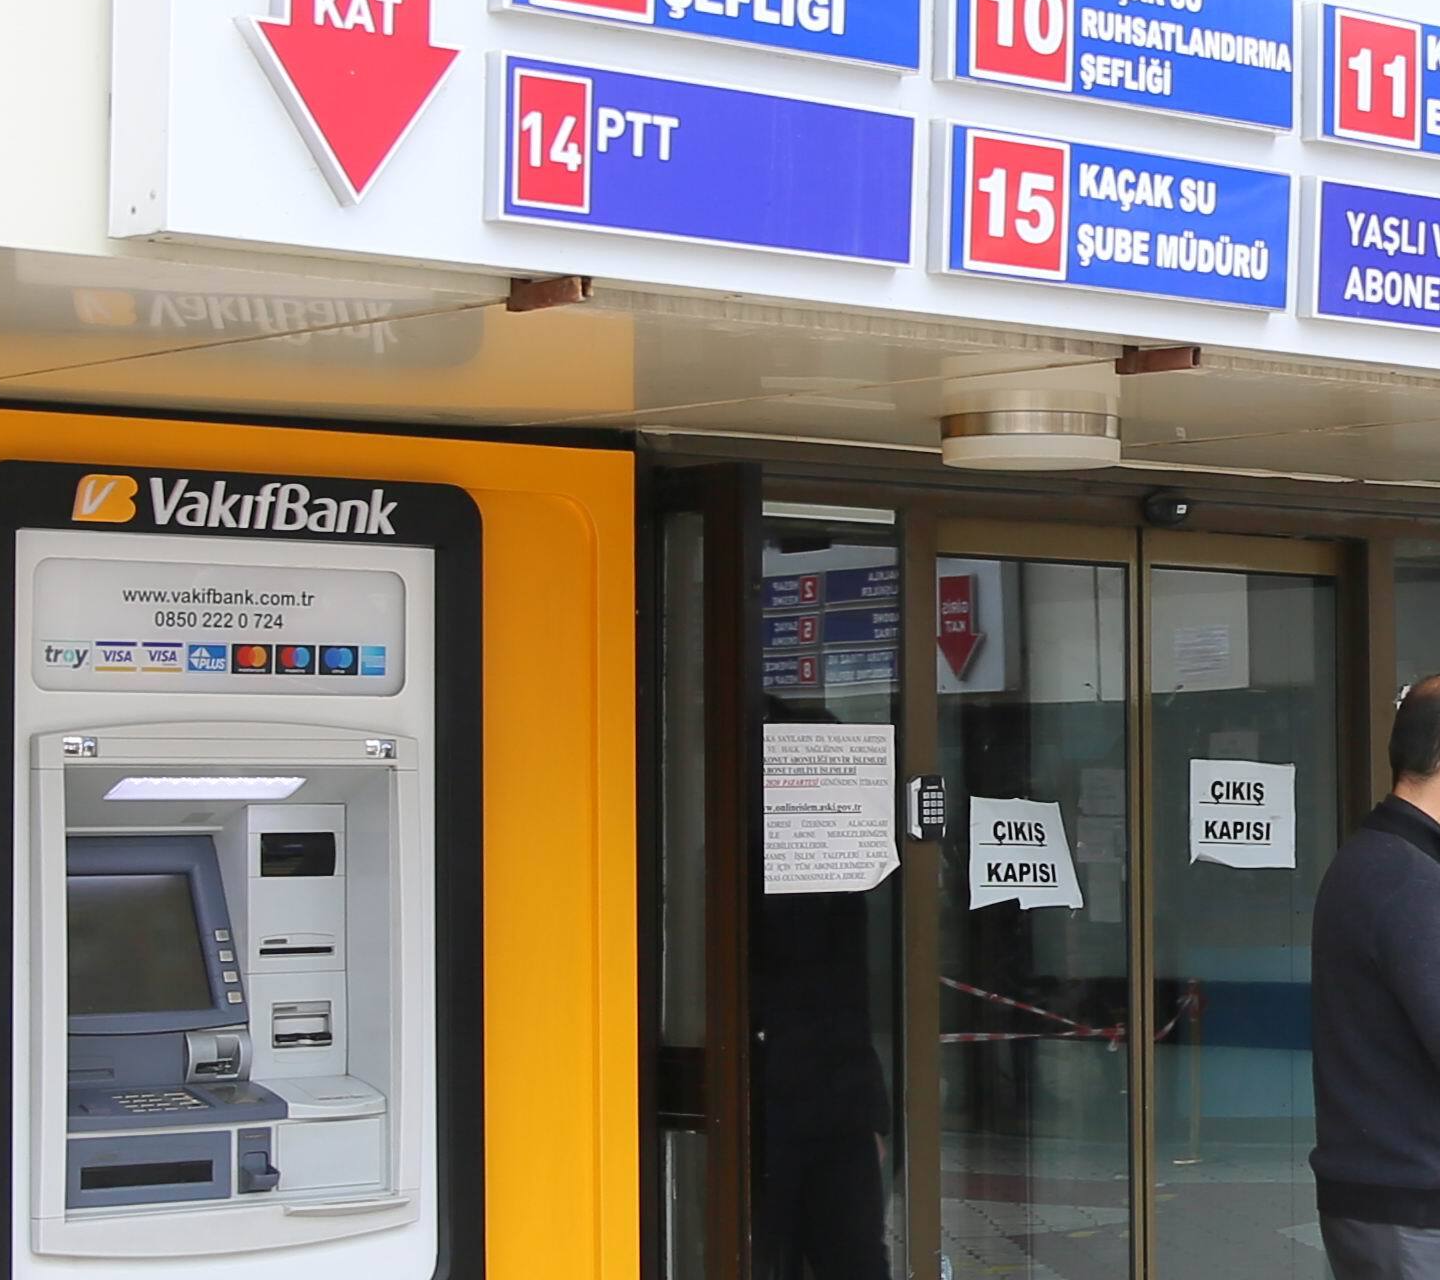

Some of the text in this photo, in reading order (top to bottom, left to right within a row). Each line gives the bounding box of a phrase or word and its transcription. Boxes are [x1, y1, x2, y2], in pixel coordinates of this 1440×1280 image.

[1080, 7, 1293, 73] RUHSATLANDIRMA
[1079, 55, 1173, 97] ŞEFLİĞİ
[1347, 48, 1407, 119] 11
[520, 109, 582, 173] 14
[596, 107, 680, 161] PTT
[978, 167, 1057, 245] 15
[1079, 163, 1217, 215] KAÇAK SU
[1346, 210, 1425, 258] YAŞLI
[1076, 222, 1270, 281] ŞUBE MÜDÜRÜ
[148, 476, 398, 535] VakıfBank
[122, 587, 316, 607] www.vakifbank.com.tr
[154, 611, 284, 629] 0850 222 0 724
[44, 645, 89, 669] troy
[102, 649, 133, 663] VISA
[148, 649, 178, 663] VISA
[200, 656, 227, 671] PLUS
[1210, 779, 1265, 806] ÇIKIŞ
[992, 820, 1046, 846] ÇIKIŞ
[1204, 819, 1272, 842] KAPISI
[986, 861, 1058, 885] KAPISI
